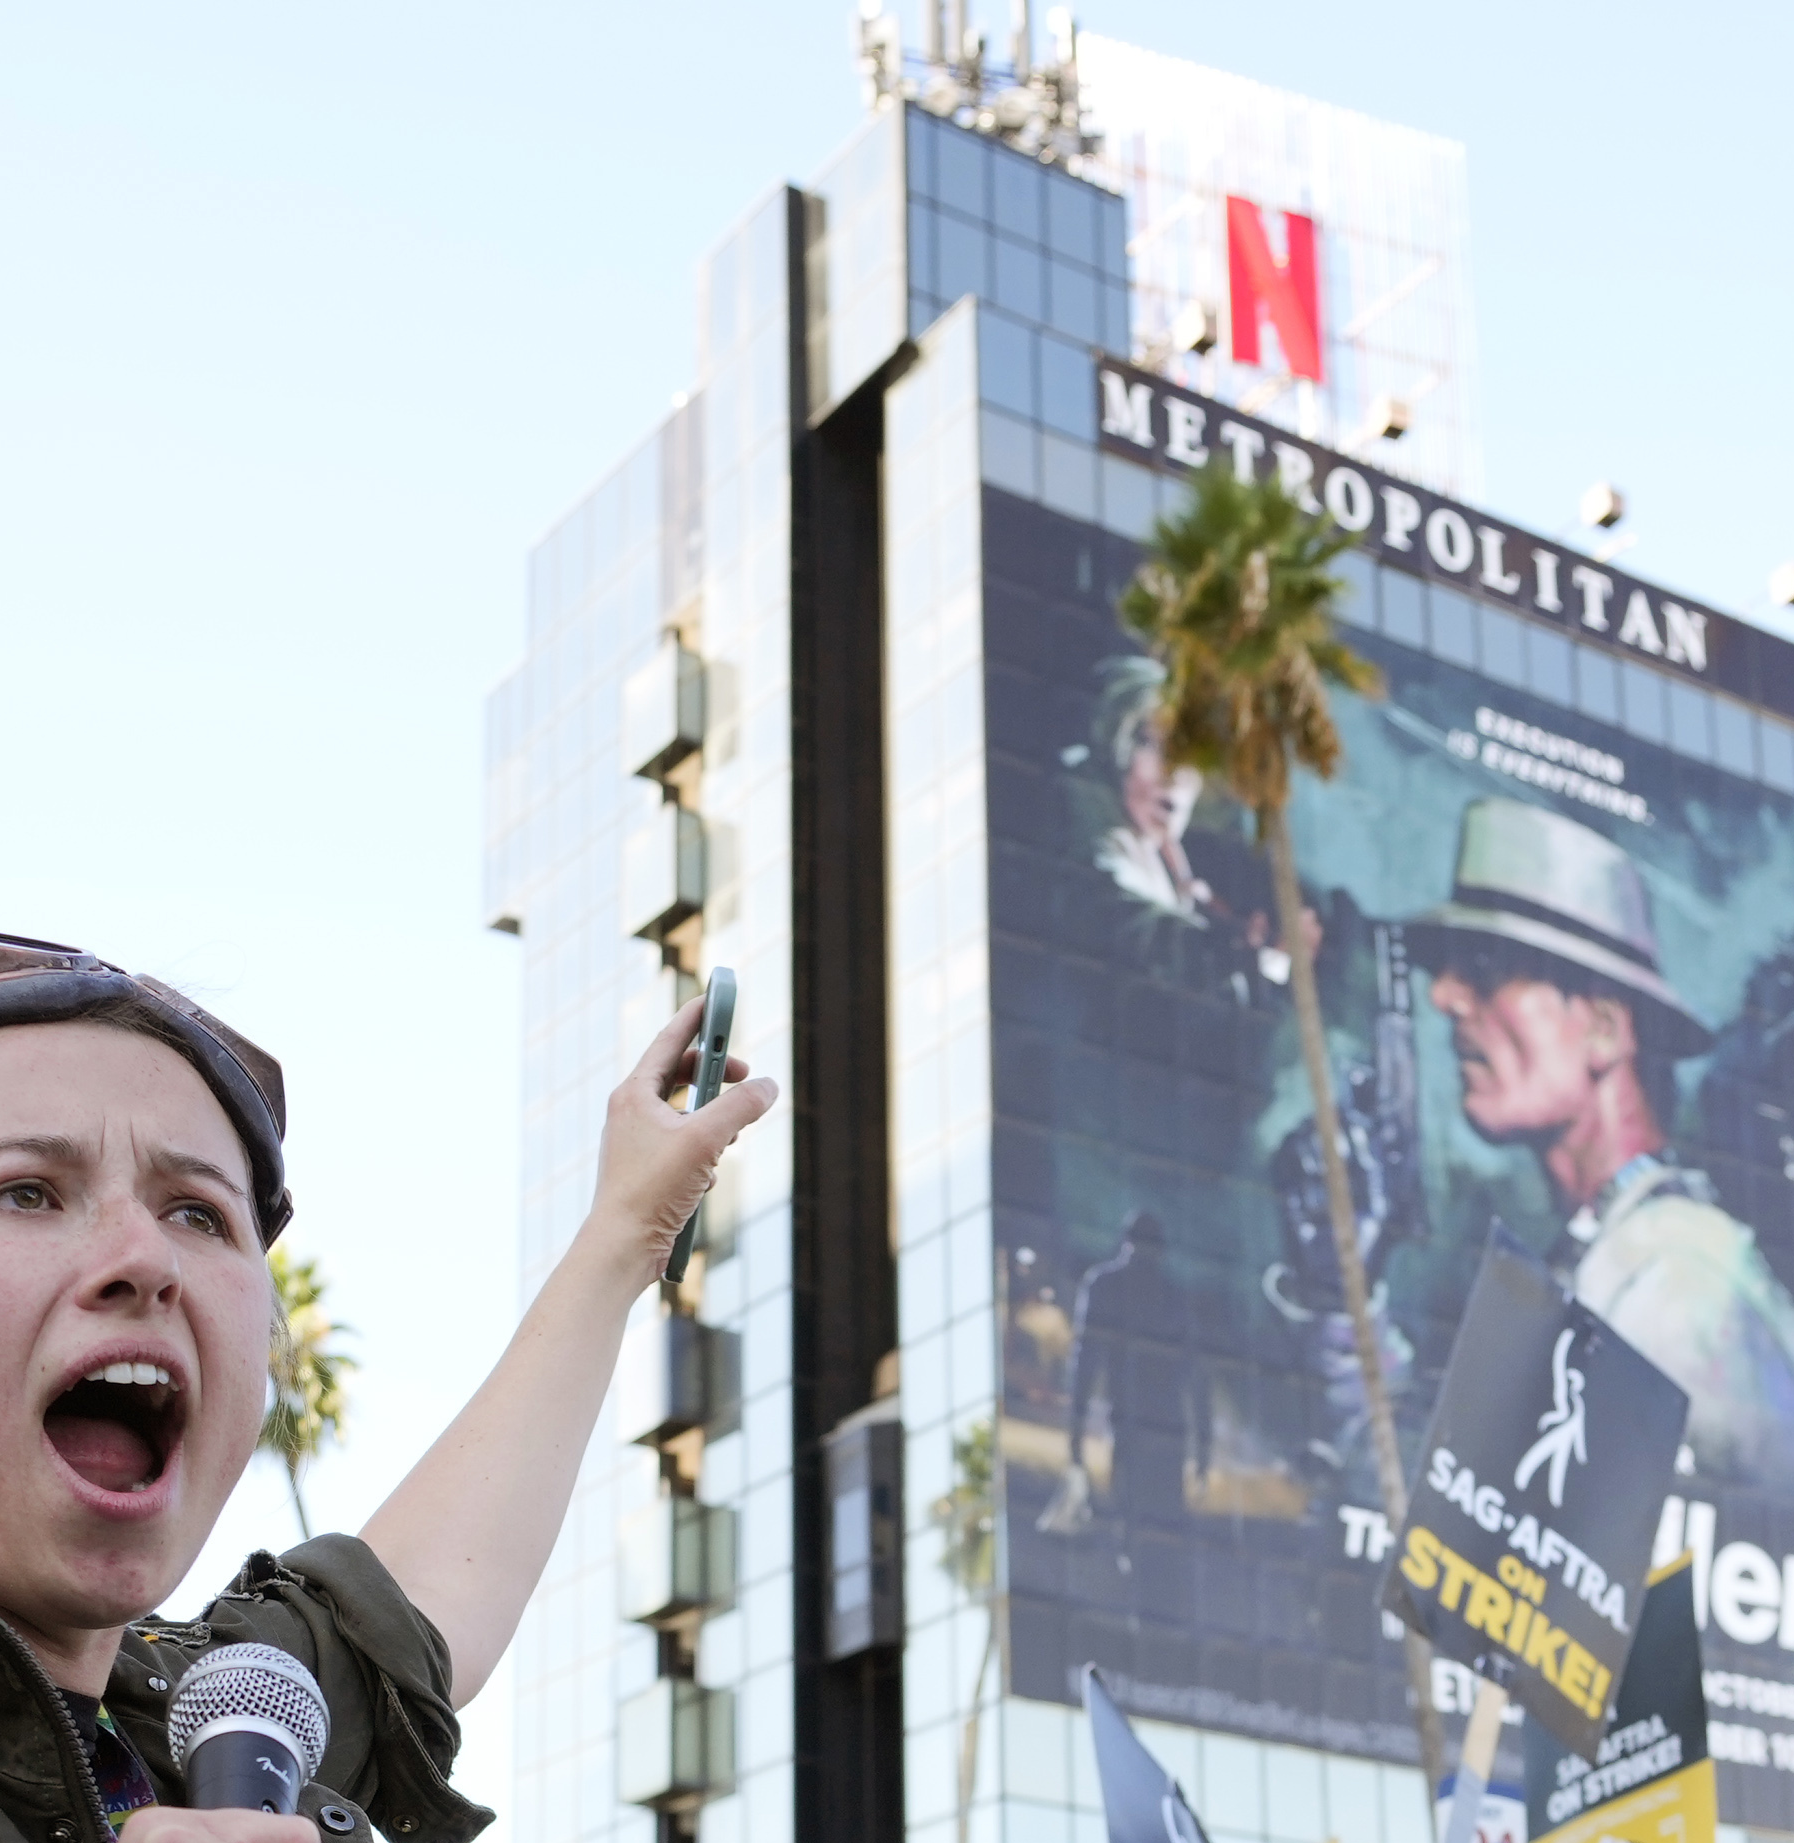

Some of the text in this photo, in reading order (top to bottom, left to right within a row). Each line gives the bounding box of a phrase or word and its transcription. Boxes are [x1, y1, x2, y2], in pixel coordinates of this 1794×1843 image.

[1100, 368, 1709, 674] METROPOLITAN
[1398, 1524, 1613, 1721] STRIKE!
[1496, 1553, 1548, 1607] ON
[1546, 1778, 1583, 1823] ON
